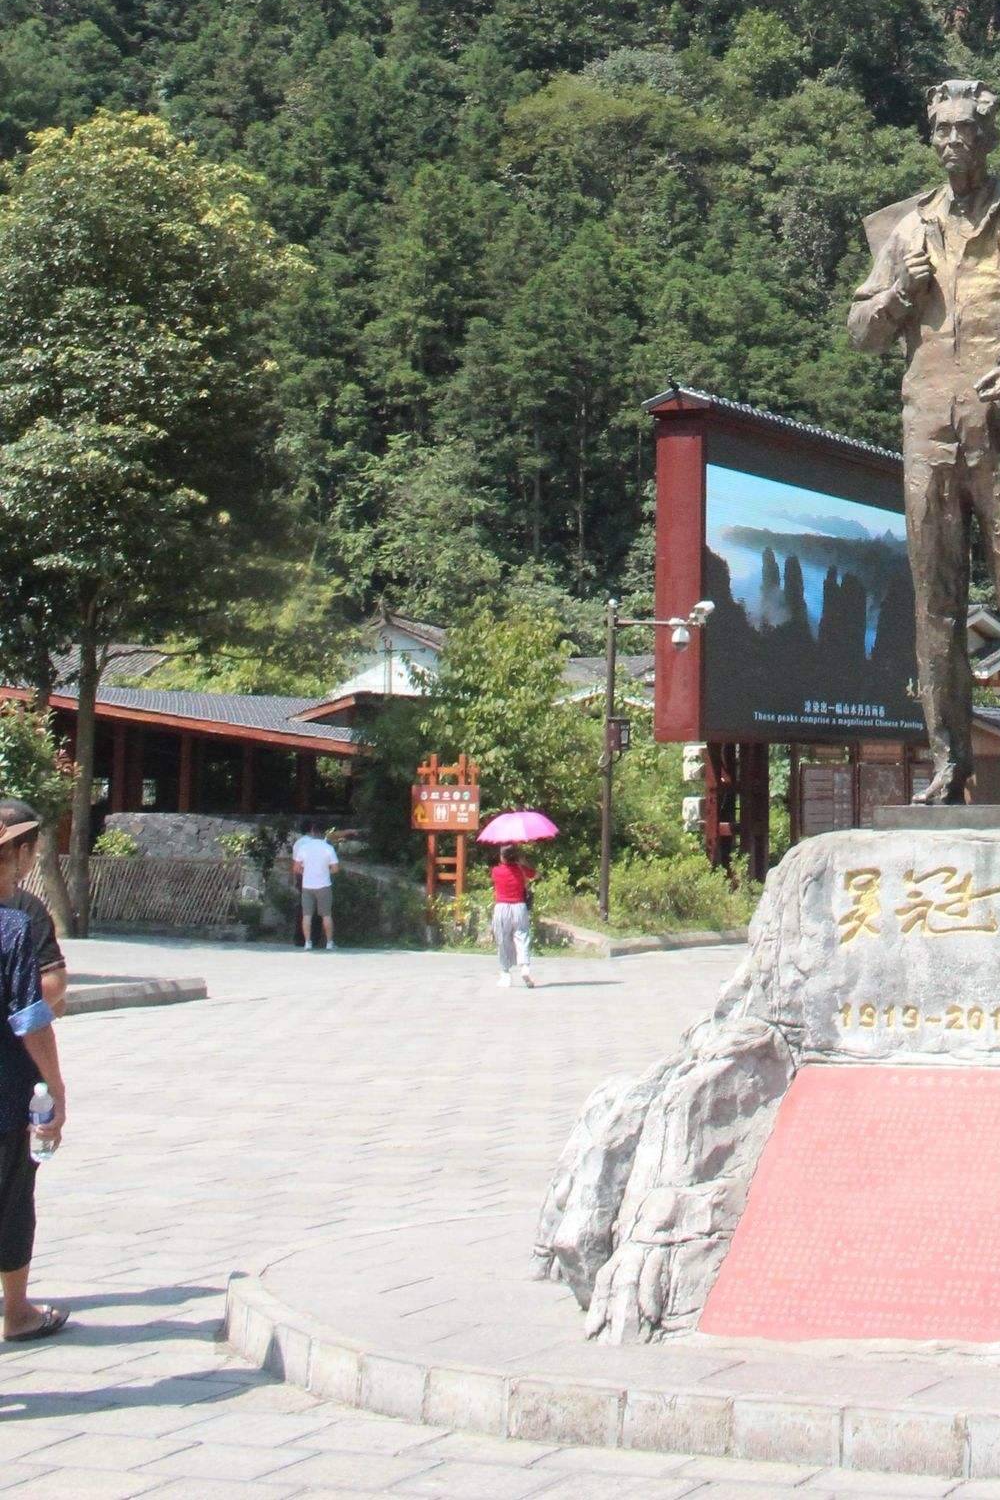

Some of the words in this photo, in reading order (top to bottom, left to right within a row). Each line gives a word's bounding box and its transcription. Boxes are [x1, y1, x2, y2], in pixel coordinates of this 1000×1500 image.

[754, 711, 775, 722] These
[777, 714, 798, 724] peaks
[800, 715, 830, 725] comprise
[875, 718, 898, 728] Chinese
[900, 720, 924, 731] Painting
